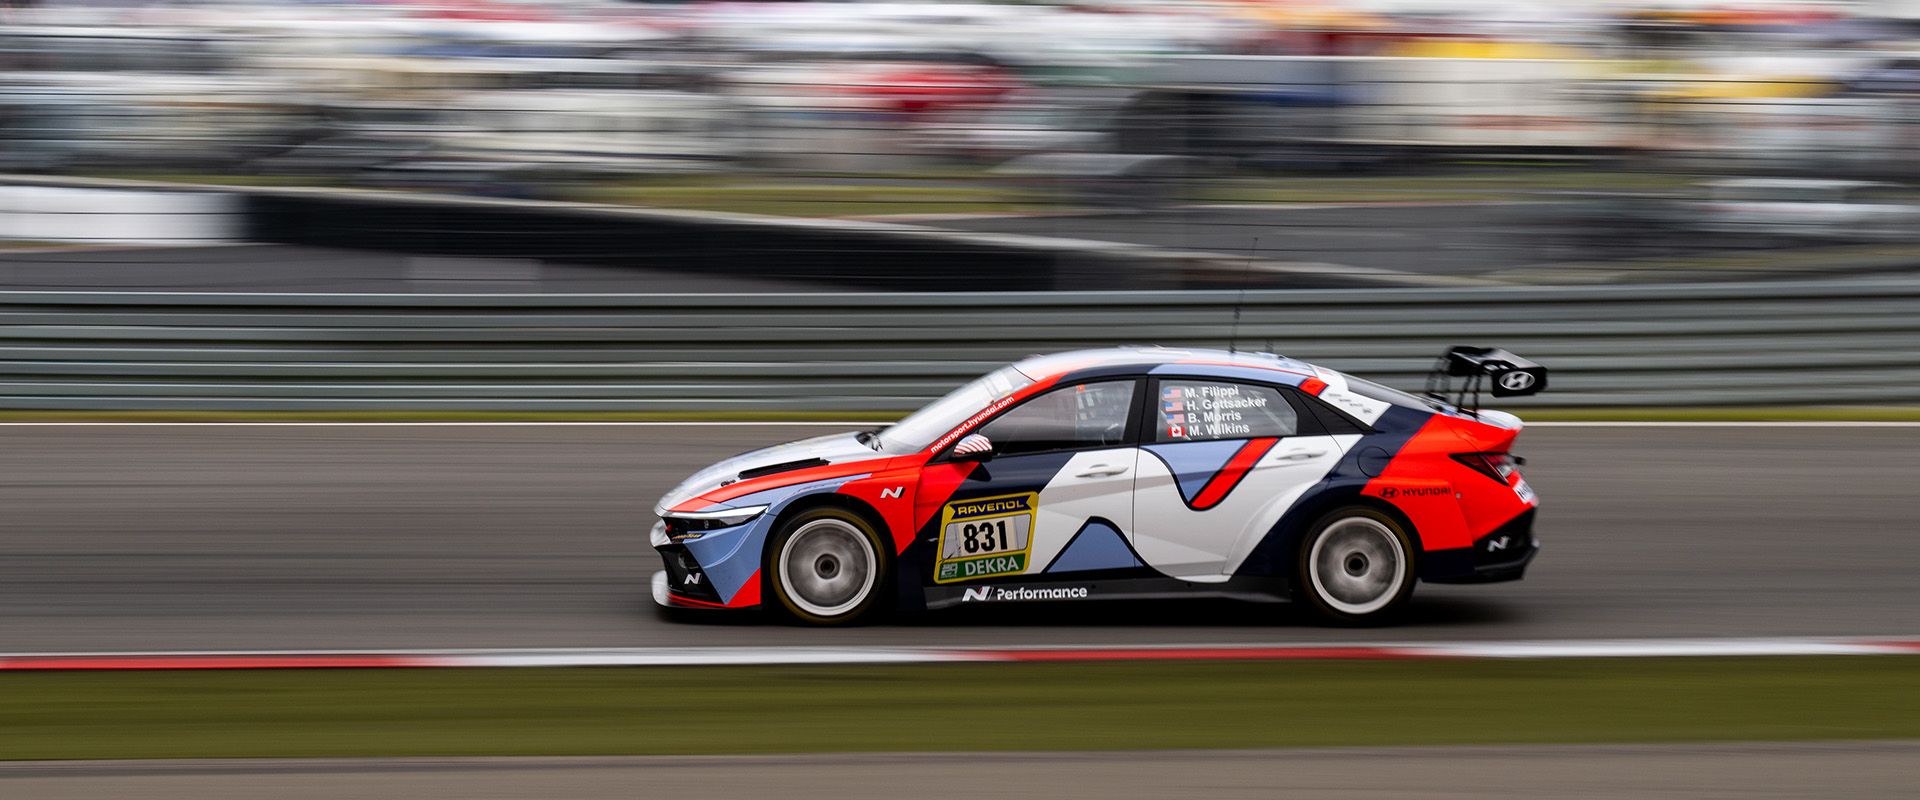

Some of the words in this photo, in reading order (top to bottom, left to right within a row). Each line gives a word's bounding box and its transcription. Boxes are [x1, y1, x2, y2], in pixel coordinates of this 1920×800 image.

[1184, 387, 1199, 398] M.
[1201, 385, 1240, 398] Filippi
[1186, 400, 1200, 411] H.
[1202, 397, 1268, 410] Gottsacker
[1187, 413, 1201, 423] B.
[1203, 410, 1242, 422] Morris
[930, 396, 1015, 453] motorsport.hyundai.com
[1189, 425, 1204, 437] M.
[1205, 423, 1250, 436] Wilkins
[1402, 487, 1452, 497] HYUNDAI
[957, 500, 1025, 516] RAVENOL
[963, 520, 1008, 554] 831
[964, 556, 1019, 576] DEKRA
[997, 586, 1088, 601] Performance
